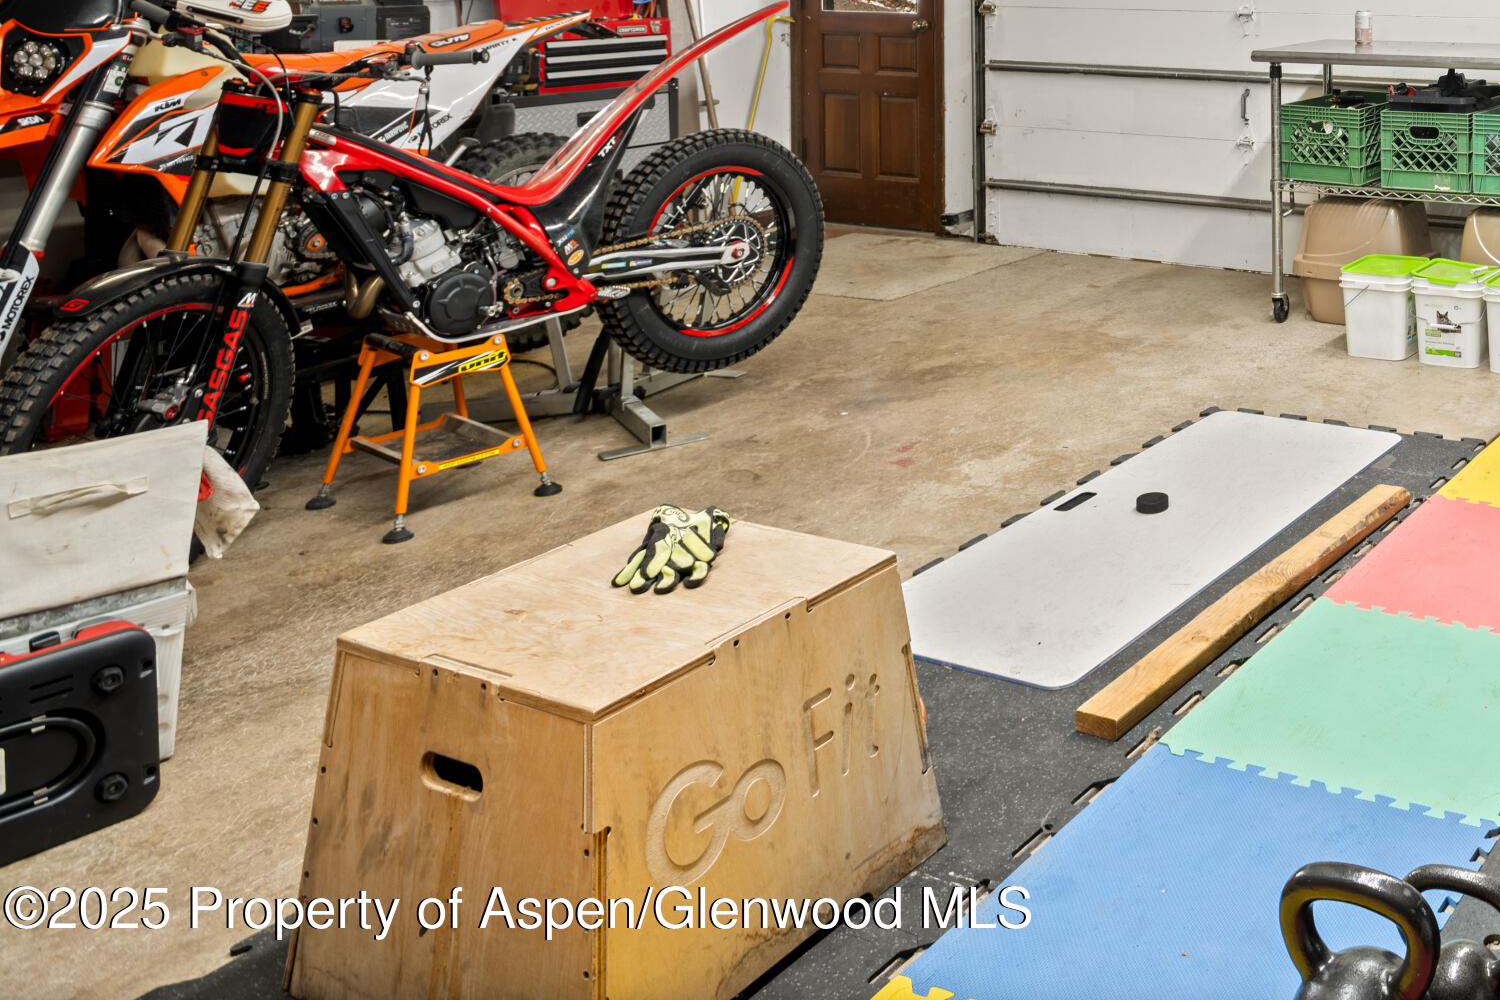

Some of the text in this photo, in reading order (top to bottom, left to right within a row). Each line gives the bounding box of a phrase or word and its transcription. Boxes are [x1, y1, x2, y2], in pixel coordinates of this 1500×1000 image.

[155, 98, 181, 112] KTM
[2, 275, 34, 330] MOTOREX
[645, 673, 881, 887] Go Fit
